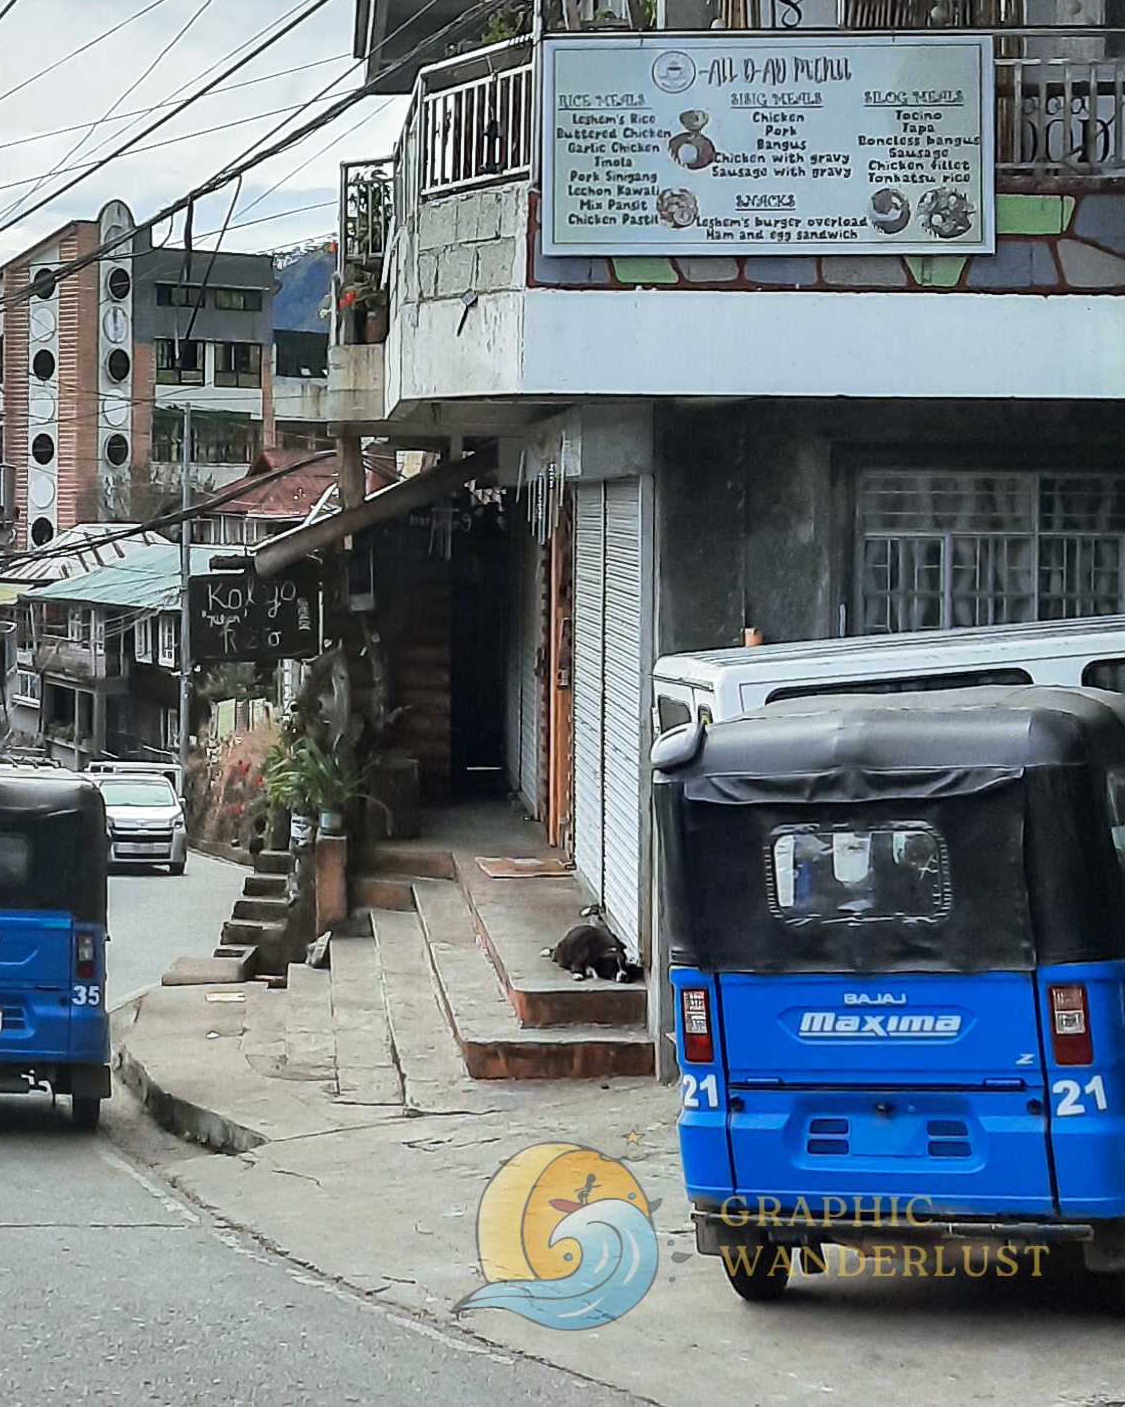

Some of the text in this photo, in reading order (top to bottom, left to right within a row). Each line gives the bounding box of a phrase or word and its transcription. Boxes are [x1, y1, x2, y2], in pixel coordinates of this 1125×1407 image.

[558, 94, 646, 108] RICE MEALS
[772, 92, 822, 106] MEALS
[912, 90, 964, 104] MEALS
[630, 113, 656, 124] Rice
[752, 111, 805, 123] Chicken
[895, 109, 943, 121] Tocino
[556, 127, 672, 139] Buttered Chicken
[765, 124, 798, 136] Pork
[902, 122, 935, 135] Tapa
[756, 138, 808, 151] Bangus
[858, 135, 980, 147] Boneless bangus
[567, 142, 660, 154] Garlic Chicken
[888, 147, 949, 160] Sausage
[714, 152, 850, 165] Chicken with gravy
[868, 160, 971, 171] Chicken fillet
[569, 170, 600, 182] Pork
[711, 166, 852, 178] Sausage with gravy
[868, 172, 971, 184] Tonkatsu rice
[568, 184, 612, 196] Lechon
[579, 199, 648, 211] Mix Pansit
[735, 194, 797, 208] SNACKS
[568, 213, 617, 225] Chicken
[754, 216, 803, 229] burger
[807, 216, 868, 228] overload
[706, 228, 858, 242] Ham and egg sandwich
[71, 984, 101, 1006] 35
[843, 993, 907, 1005] BAJAJ
[682, 1074, 718, 1108] 21
[1052, 1075, 1108, 1117] 21
